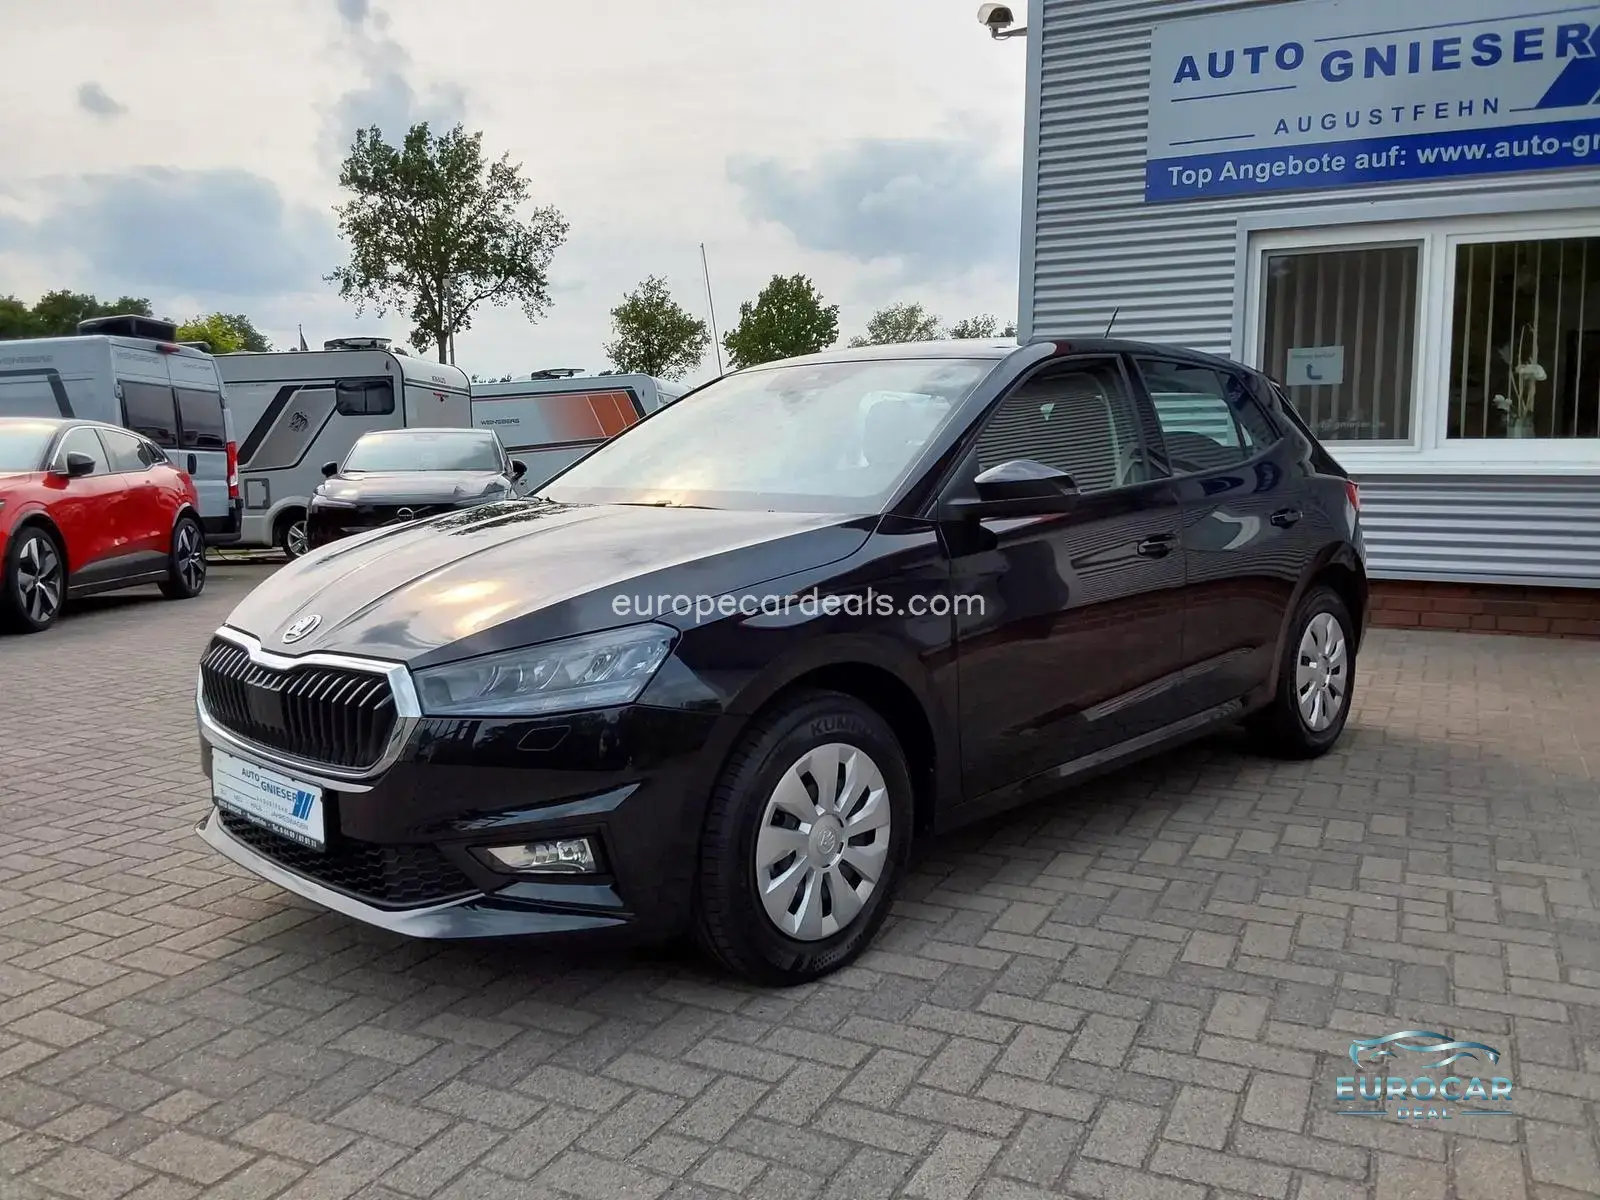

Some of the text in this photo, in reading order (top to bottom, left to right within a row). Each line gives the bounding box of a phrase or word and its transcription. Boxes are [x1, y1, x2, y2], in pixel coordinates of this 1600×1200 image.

[1173, 23, 1591, 83] AUTO GNIESER
[1274, 97, 1499, 135] AUGUSTFEHN
[1168, 165, 1212, 188] Top
[1220, 150, 1346, 183] Angebote
[1355, 143, 1406, 170] auf:
[242, 767, 260, 782] AUTO
